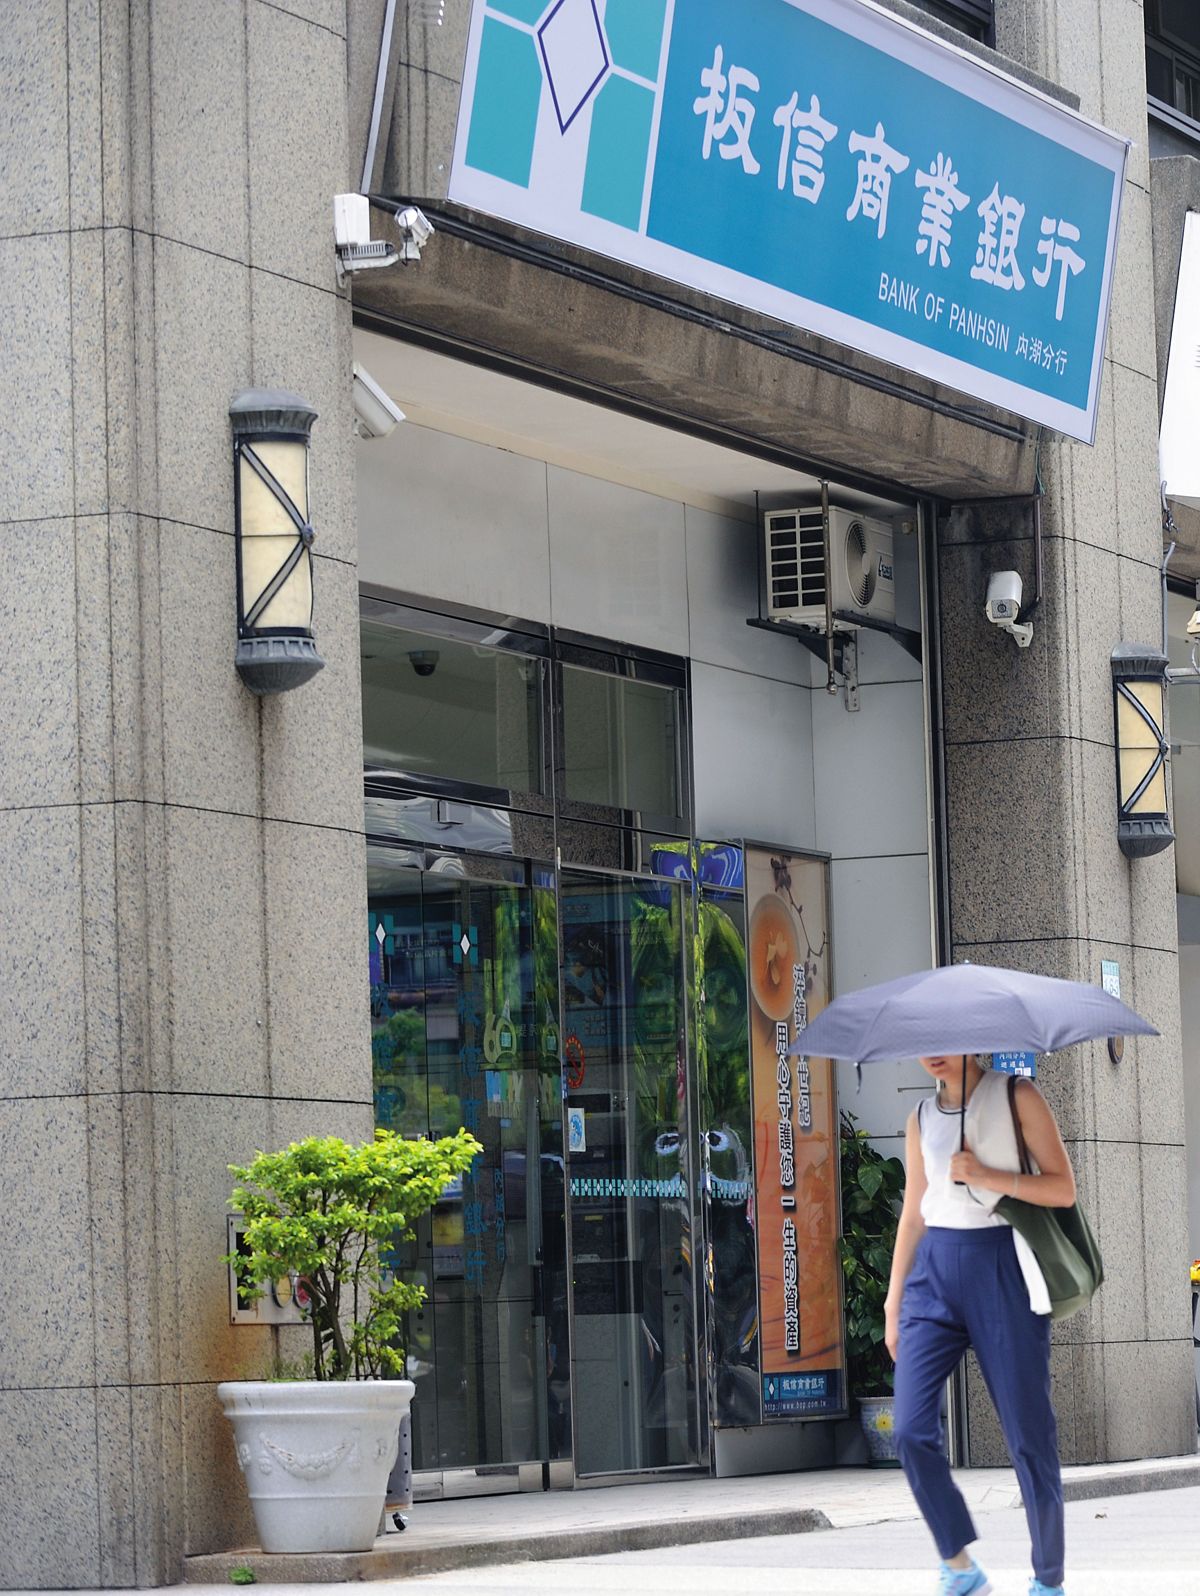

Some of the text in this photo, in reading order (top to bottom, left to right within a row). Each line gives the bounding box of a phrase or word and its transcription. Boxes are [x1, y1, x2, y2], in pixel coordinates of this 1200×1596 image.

[692, 43, 1087, 322] 板信商業銀行
[878, 272, 1068, 376] BANK OF PANHSIN 內湖分行
